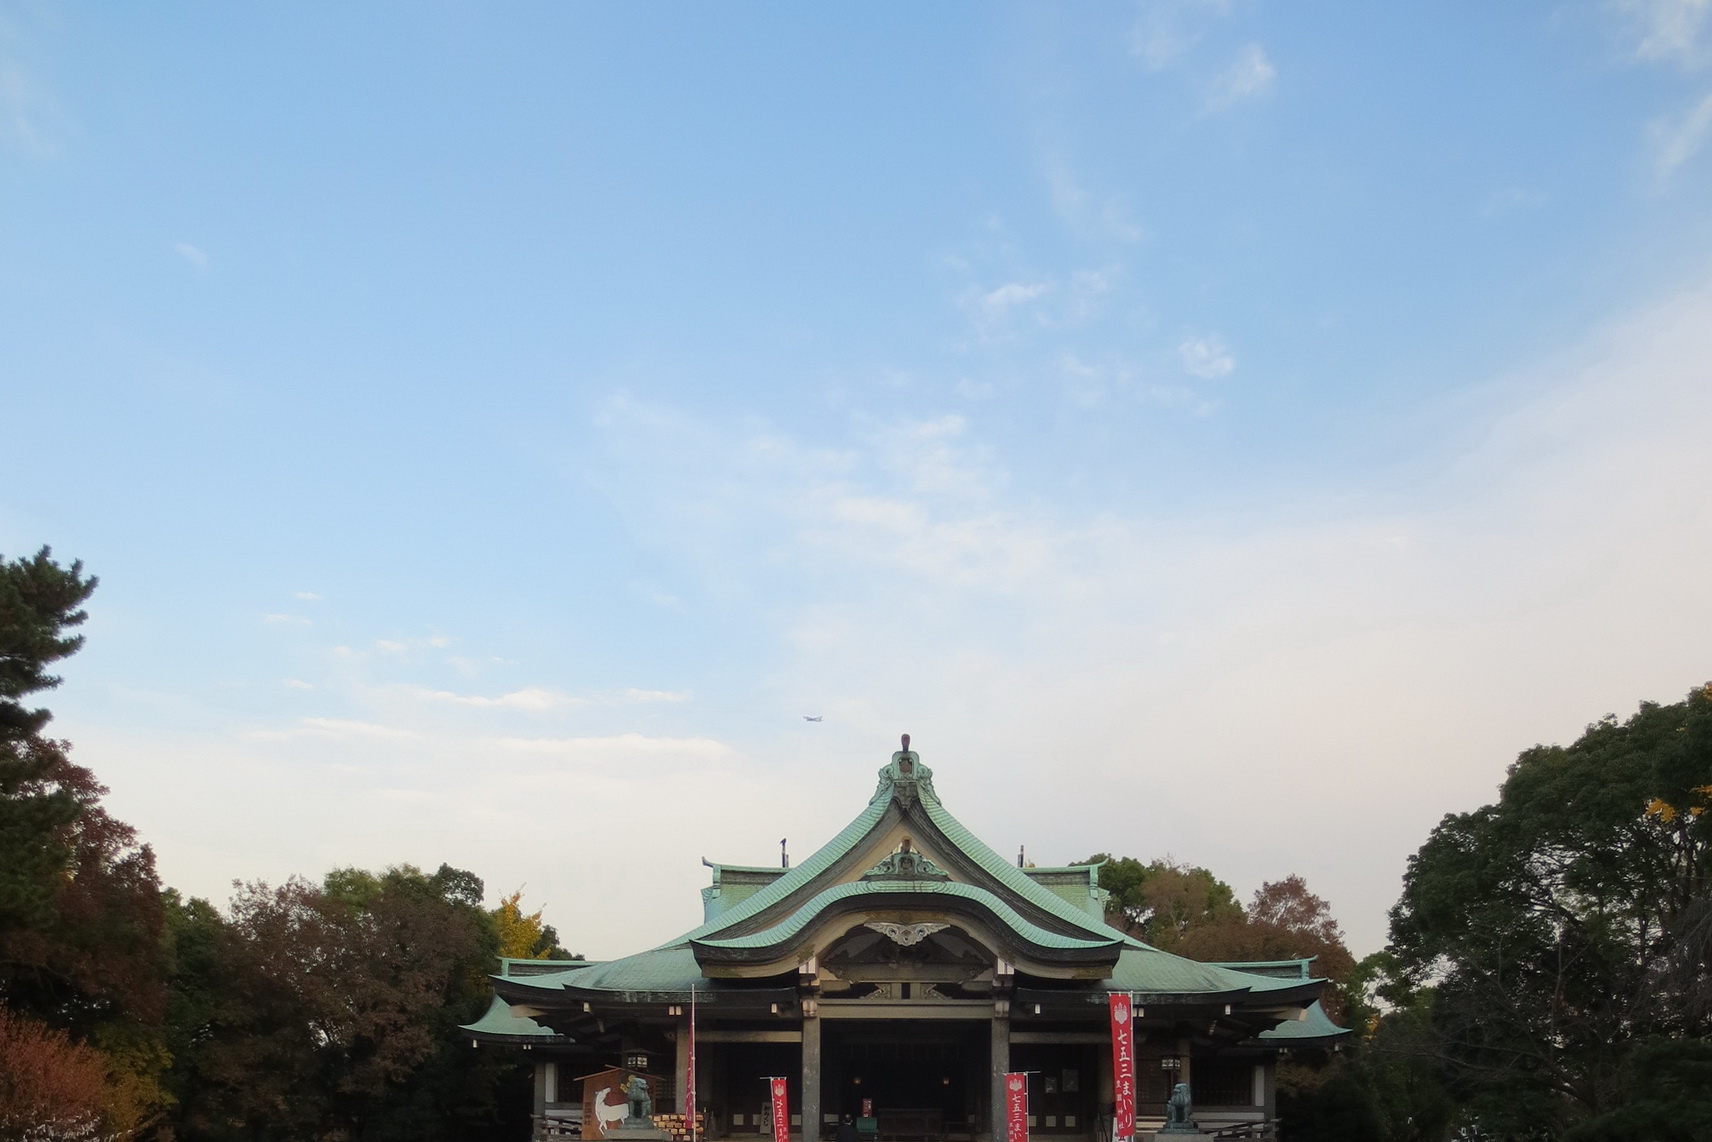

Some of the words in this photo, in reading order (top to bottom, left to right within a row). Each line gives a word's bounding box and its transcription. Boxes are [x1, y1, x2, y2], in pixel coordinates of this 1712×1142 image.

[1117, 1029, 1132, 1128] 七五三まいり
